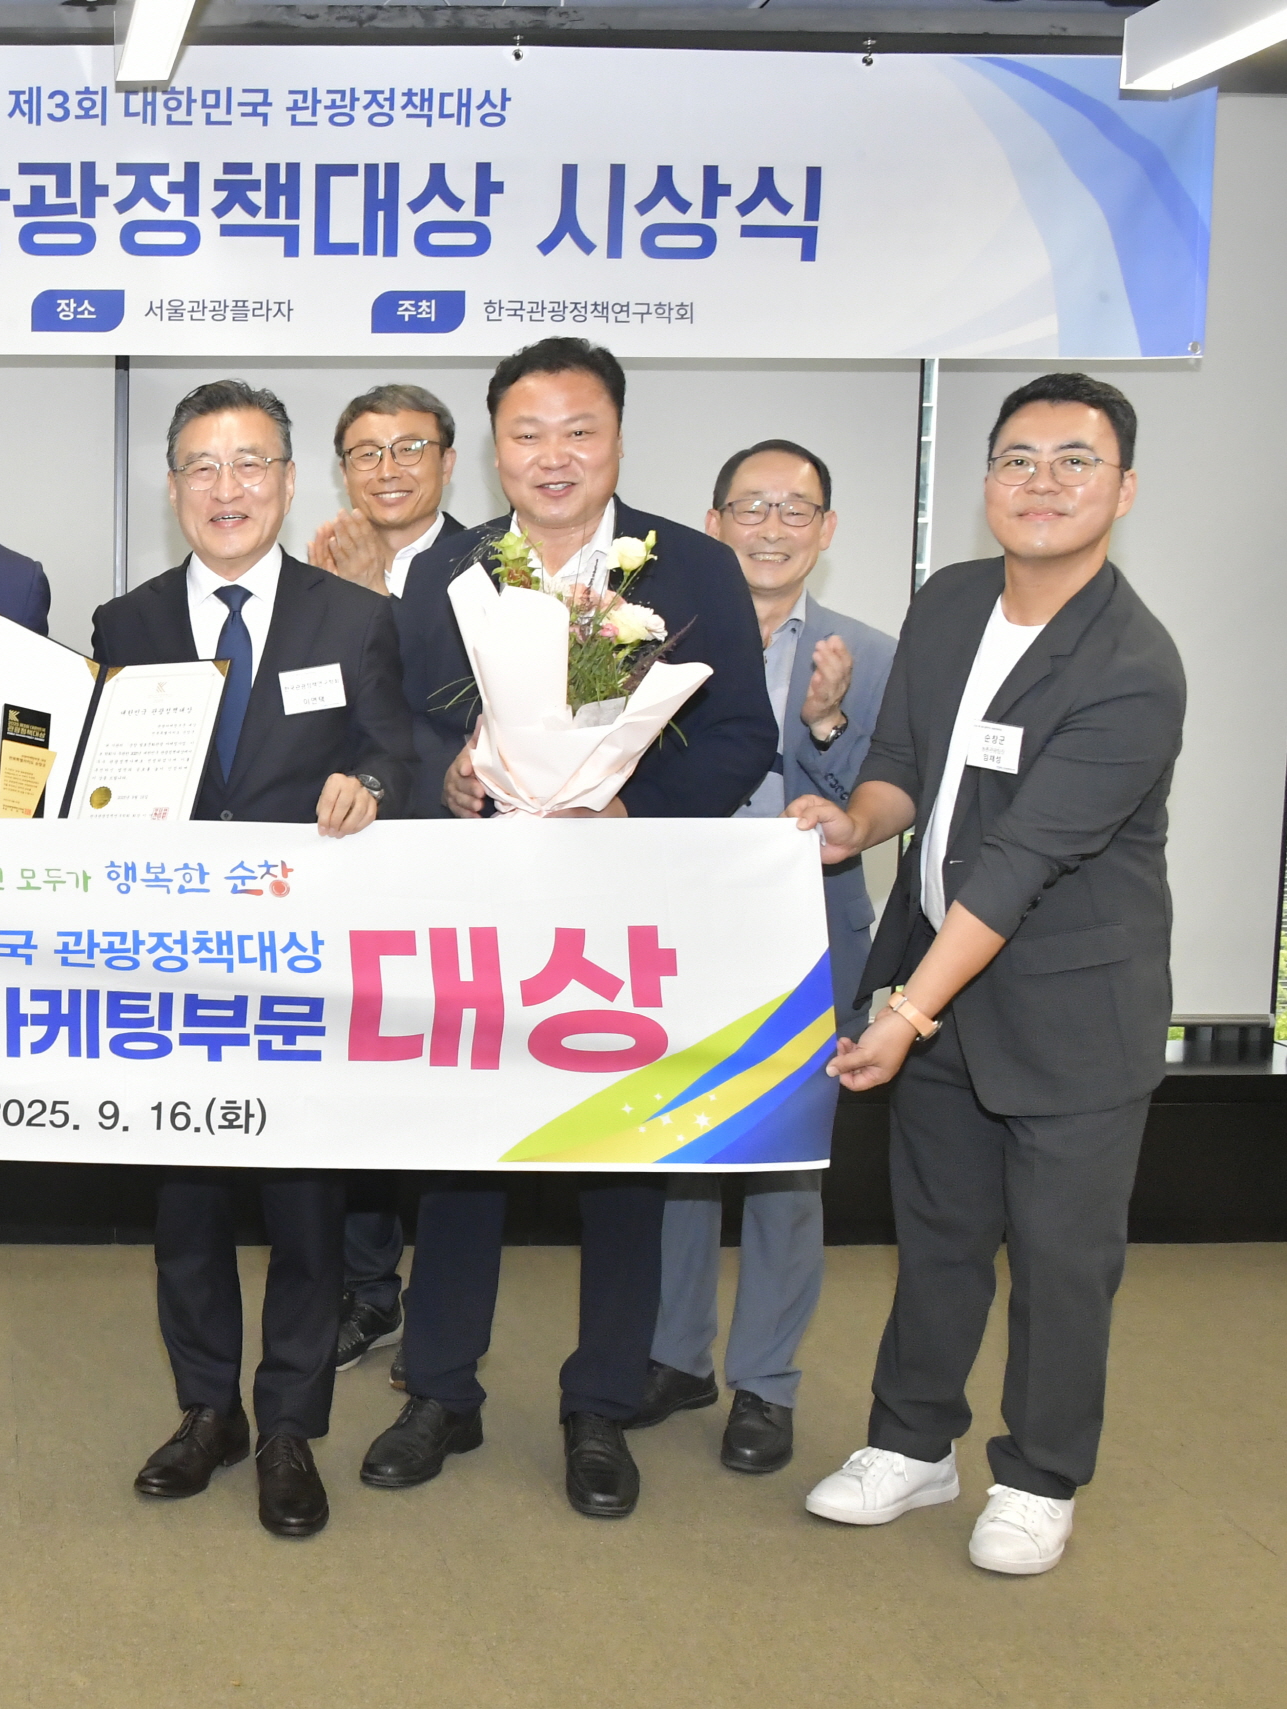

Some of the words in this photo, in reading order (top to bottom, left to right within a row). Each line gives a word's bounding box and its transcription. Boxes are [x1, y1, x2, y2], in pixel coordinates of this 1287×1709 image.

[8, 86, 107, 126] 제3회
[124, 87, 273, 127] 대한민국
[286, 87, 511, 127] 관광정책대상
[536, 163, 822, 262] 시상식
[57, 298, 96, 320] 장소
[145, 299, 294, 322] 서울관광플라자
[397, 299, 435, 321] 주최
[484, 300, 693, 324] 한국관광정책연구학회
[17, 869, 91, 892] 모두가
[105, 861, 210, 894] 행복한
[224, 860, 294, 898] 순창
[53, 929, 324, 973] 관광정책대상
[348, 925, 678, 1074] 대상
[98, 1100, 129, 1132] 9.
[151, 1097, 266, 1136] 16.(화)
